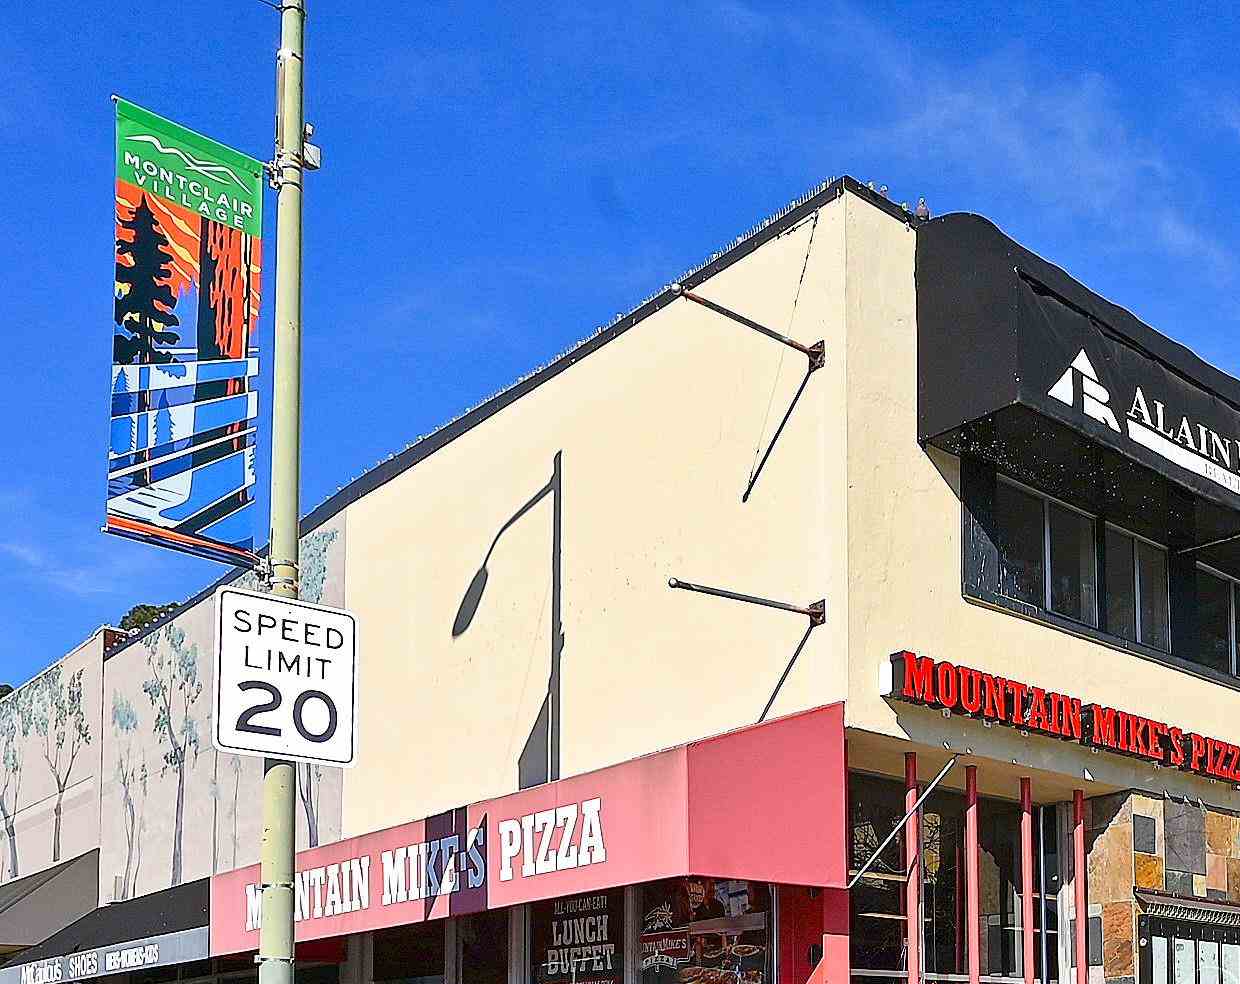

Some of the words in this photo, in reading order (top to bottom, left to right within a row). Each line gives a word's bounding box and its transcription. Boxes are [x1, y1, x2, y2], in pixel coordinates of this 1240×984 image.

[124, 151, 253, 218] MONTCLAIR
[134, 171, 244, 228] VILLAGE
[1126, 386, 1231, 469] ALAIN
[234, 609, 344, 649] SPEED
[244, 645, 332, 680] LIMIT
[235, 680, 338, 743] 20
[903, 651, 1082, 740] MOUNTAIN
[1092, 704, 1184, 765] MIKE'S
[245, 855, 371, 931] MNTAIN
[381, 828, 486, 906] MIKE'S
[498, 797, 608, 882] PIZZA
[551, 914, 608, 946] LUNCH
[68, 950, 98, 979] SHOES
[547, 944, 615, 975] BUFFET
